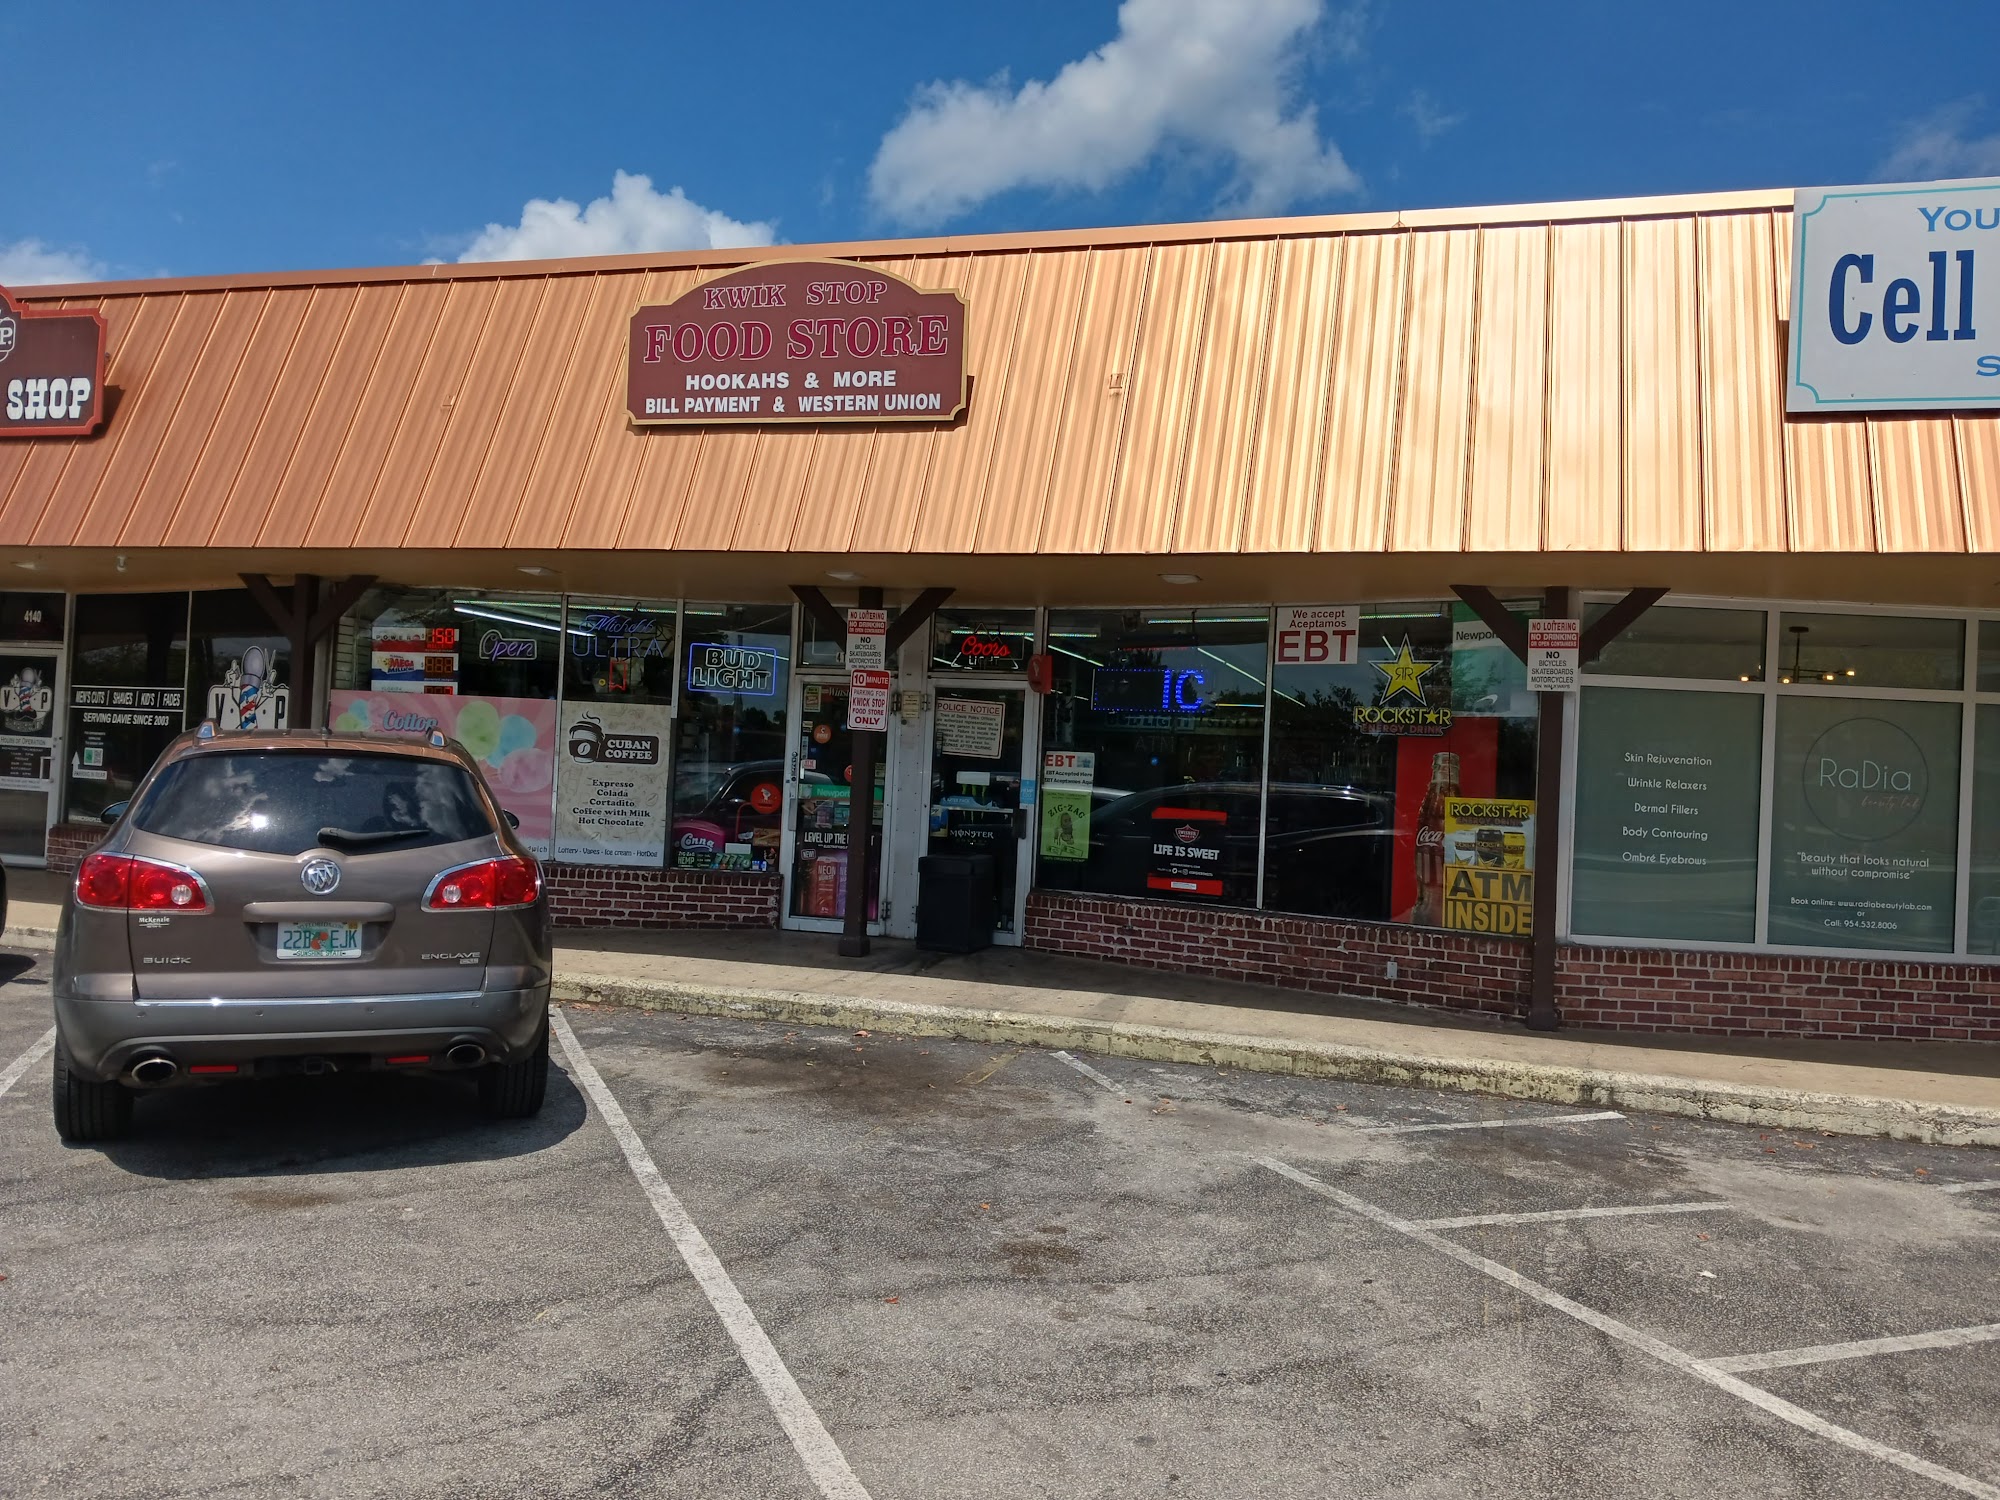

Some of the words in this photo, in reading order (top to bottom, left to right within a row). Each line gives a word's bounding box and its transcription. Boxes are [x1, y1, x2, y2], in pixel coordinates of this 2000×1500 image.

[704, 284, 786, 310] KWIK
[806, 280, 888, 306] STOP
[1829, 250, 1976, 345] Cell
[643, 321, 772, 363] FOOD
[786, 314, 948, 360] STORE
[686, 372, 790, 390] HOOKAHS
[804, 372, 820, 388] &
[833, 370, 896, 388] MORE
[6, 377, 91, 420] SHOP
[645, 398, 680, 414] BILL
[684, 396, 760, 413] PAYMENT
[772, 396, 786, 412] &
[798, 394, 879, 412] WESTERN
[884, 393, 941, 410] UNION
[24, 610, 42, 623] 4140
[1292, 610, 1308, 619] We
[1310, 608, 1346, 620] accept
[1289, 618, 1346, 630] Aceptamos
[1532, 622, 1541, 630] NO
[1544, 622, 1576, 631] LOITERING
[432, 628, 454, 644] 150
[482, 632, 533, 662] Open
[572, 636, 664, 658] ULTRA
[961, 636, 1011, 656] Coors
[1278, 630, 1356, 662] EBT
[706, 648, 761, 670] BUD
[693, 667, 771, 690] LIGHT
[854, 673, 866, 684] 10
[866, 676, 889, 685] MINUTE
[112, 692, 133, 705] SHAVES
[140, 693, 155, 706] KID'S
[162, 694, 180, 706] FADES
[852, 697, 870, 707] KWICK
[872, 698, 885, 708] STOP
[937, 702, 967, 712] POLICE
[970, 705, 1000, 714] NOTICE
[83, 712, 111, 724] SERVING
[112, 713, 132, 724] DAVIE
[132, 714, 153, 726] SINCE
[154, 716, 169, 726] 2003
[854, 716, 881, 725] ONLY
[1410, 725, 1442, 733] DRINK
[606, 740, 651, 750] CUBAN
[605, 750, 652, 760] COFFEE
[1045, 755, 1075, 768] EBT
[1624, 752, 1644, 762] Skin
[1646, 753, 1712, 766] Rejuvenation
[1820, 758, 1912, 791] RaDia
[592, 780, 634, 788] Expresso
[1628, 778, 1662, 788] Wrinkle
[1665, 779, 1707, 790] Relaxers
[589, 799, 634, 807] Cortadito
[1634, 802, 1668, 813] Dermal
[1671, 804, 1698, 815] Fillers
[629, 809, 651, 817] Milk
[1047, 804, 1086, 819] ZIG-ZAG
[598, 818, 644, 826] Chocolate
[804, 832, 823, 843] LEVEL
[824, 833, 834, 844] UP
[834, 833, 845, 844] THE
[950, 829, 994, 839] MONSTER
[1416, 826, 1442, 847] Coca
[1622, 826, 1648, 838] Body
[1652, 828, 1708, 841] Contouring
[1153, 844, 1173, 856] LIFE
[1175, 846, 1186, 857] IS
[1187, 847, 1220, 860] SWEET
[1622, 852, 1656, 863] Ombré
[1660, 854, 1706, 865] Eyebrows
[678, 857, 695, 865] HEMP
[1840, 854, 1860, 864] that
[1864, 855, 1890, 866] looks
[1892, 858, 1930, 867] natural
[818, 866, 836, 875] NEON
[1811, 866, 1847, 876] without
[1449, 870, 1532, 902] ATM
[1838, 900, 1932, 911] www.radiabeautylab.com
[1447, 901, 1532, 934] INSIDE
[1824, 919, 1842, 927] Call:
[1844, 920, 1898, 930] 954.532.8006
[331, 930, 358, 949] EJK
[143, 956, 191, 964] BUICK
[421, 952, 480, 960] ENCLAVE
